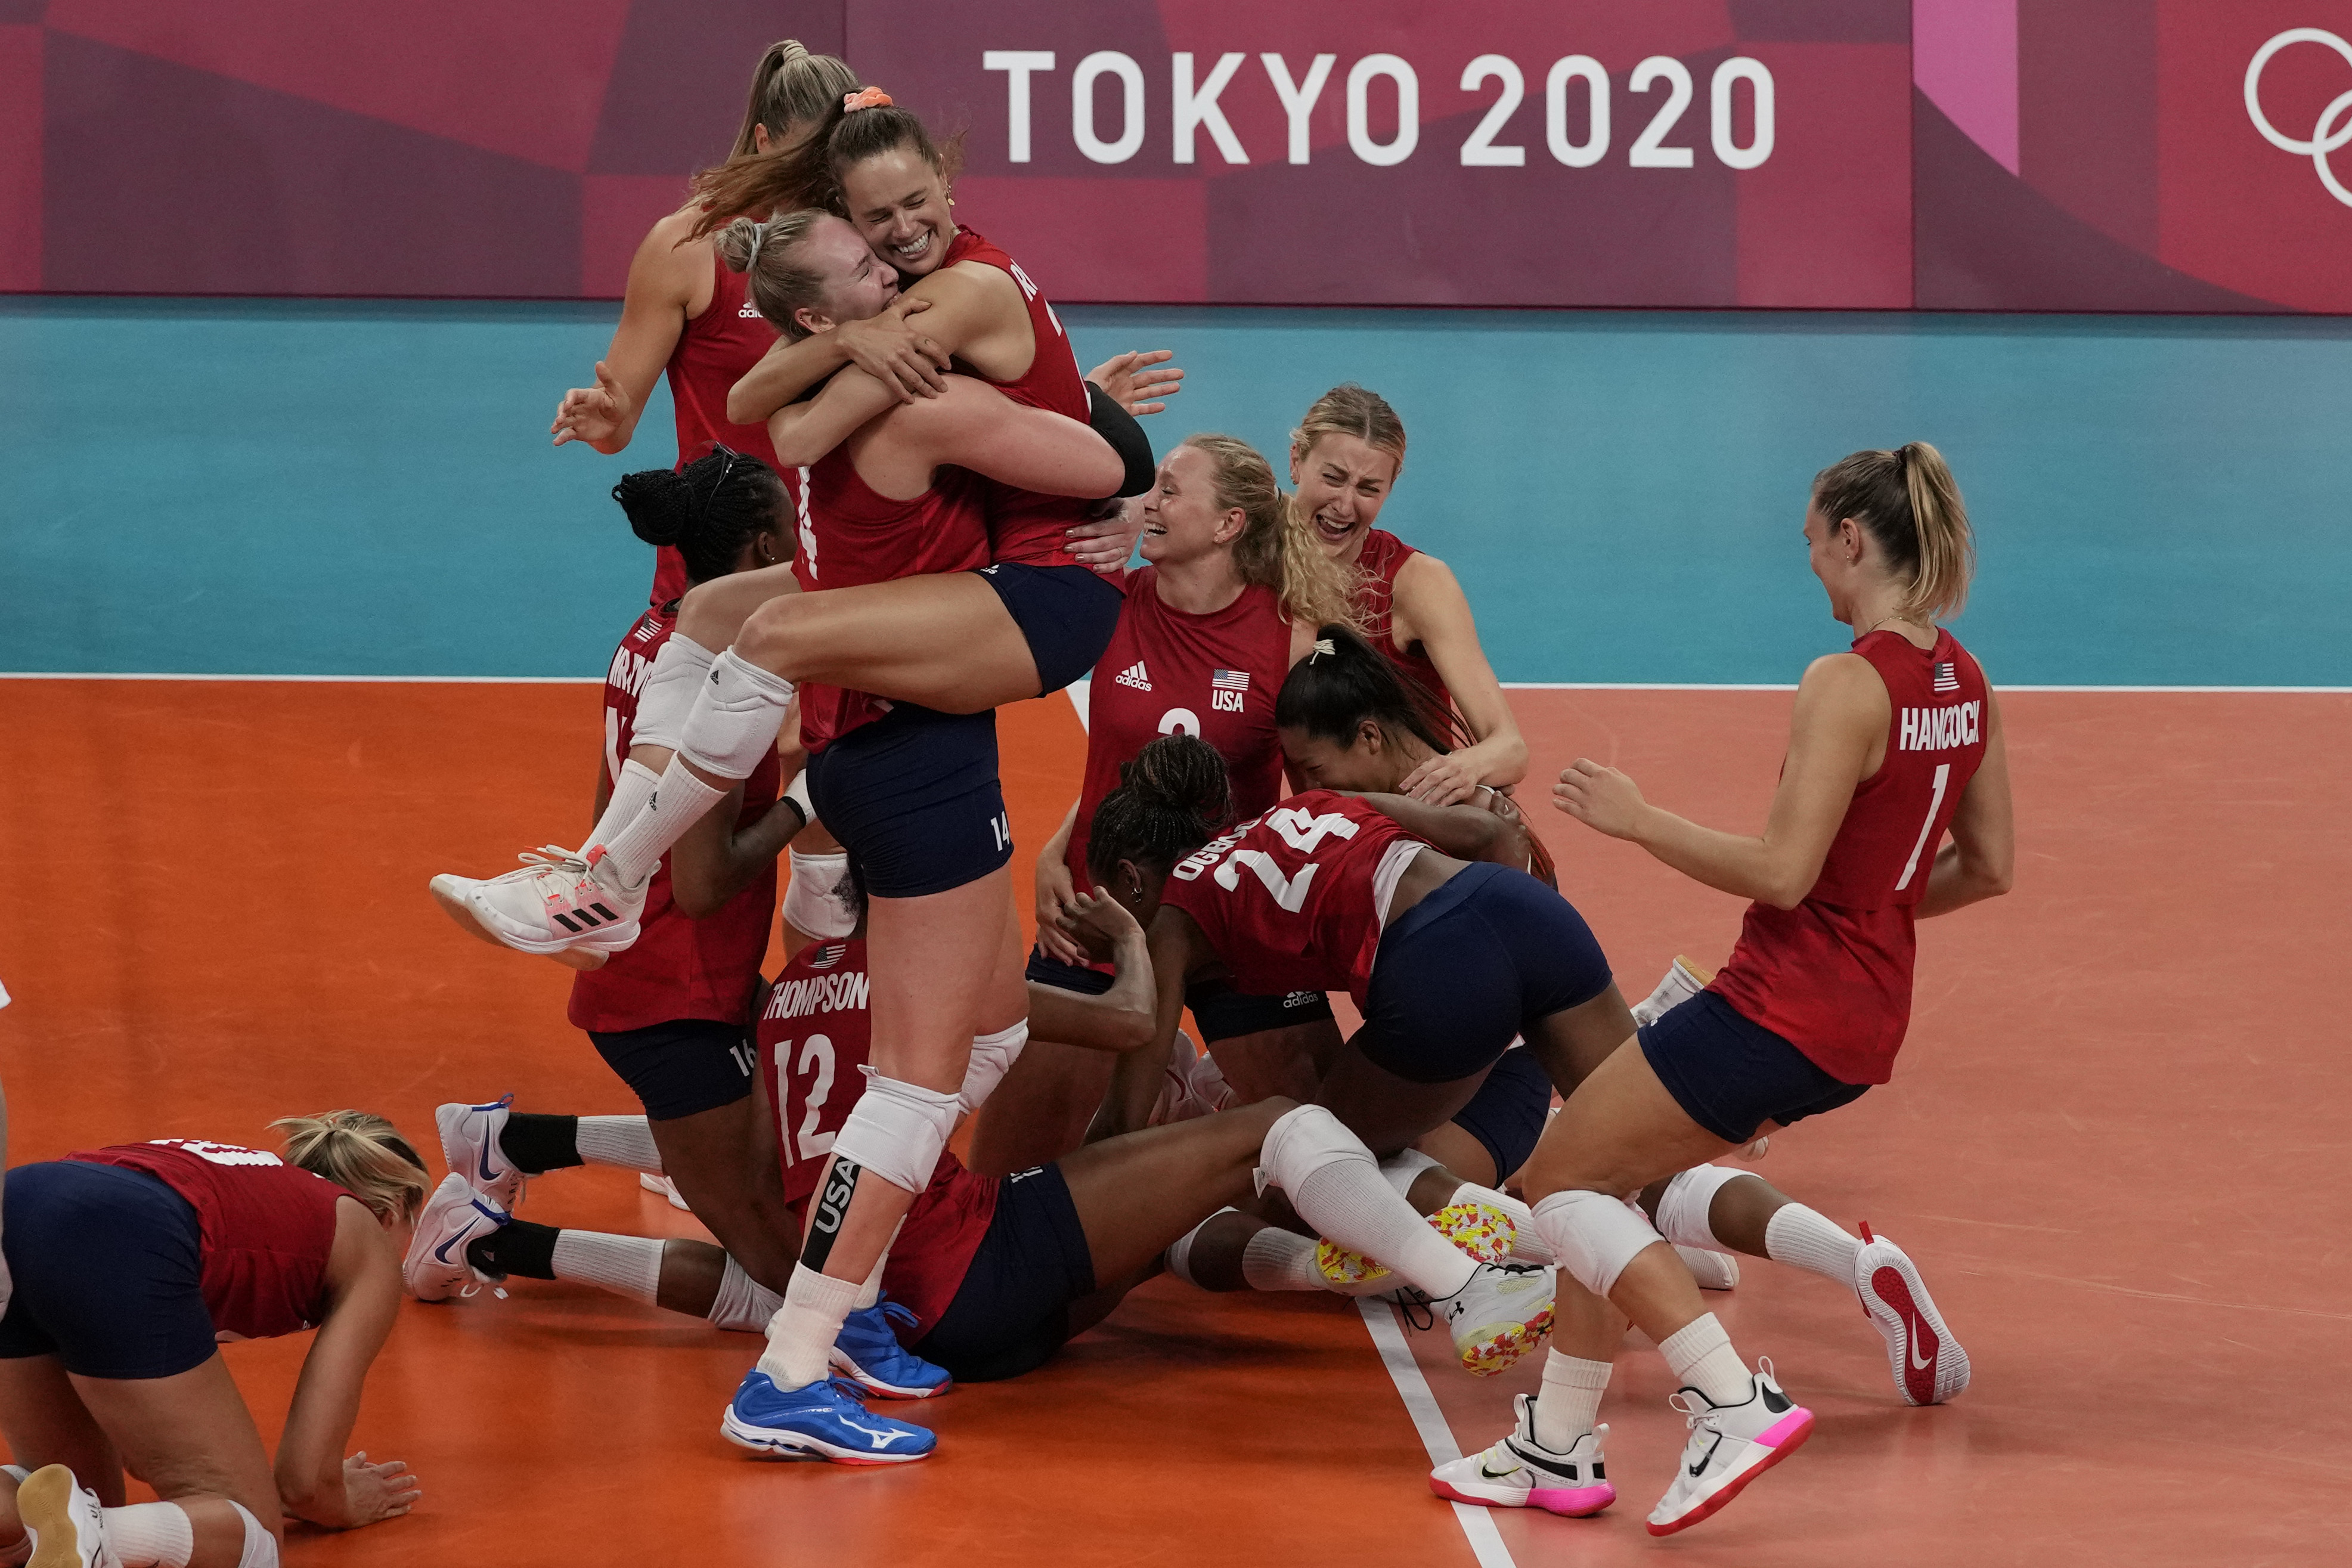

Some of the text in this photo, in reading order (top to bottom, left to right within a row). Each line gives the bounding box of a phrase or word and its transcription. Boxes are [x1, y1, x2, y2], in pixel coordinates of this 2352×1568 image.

[983, 51, 1774, 169] TOKYO 2020
[1115, 675, 1152, 692] adidas
[1211, 689, 1244, 712] USA
[1899, 700, 1980, 751] HANCOCK
[990, 810, 1010, 852] 14
[1173, 805, 1276, 881] OGBO
[1894, 763, 1950, 891] 1
[1213, 807, 1361, 913] 24
[763, 971, 870, 1020] THOMPSON
[1283, 993, 1319, 1008] adidas
[729, 1039, 757, 1077] 16
[774, 1033, 836, 1169] 12
[815, 1160, 855, 1234] USA
